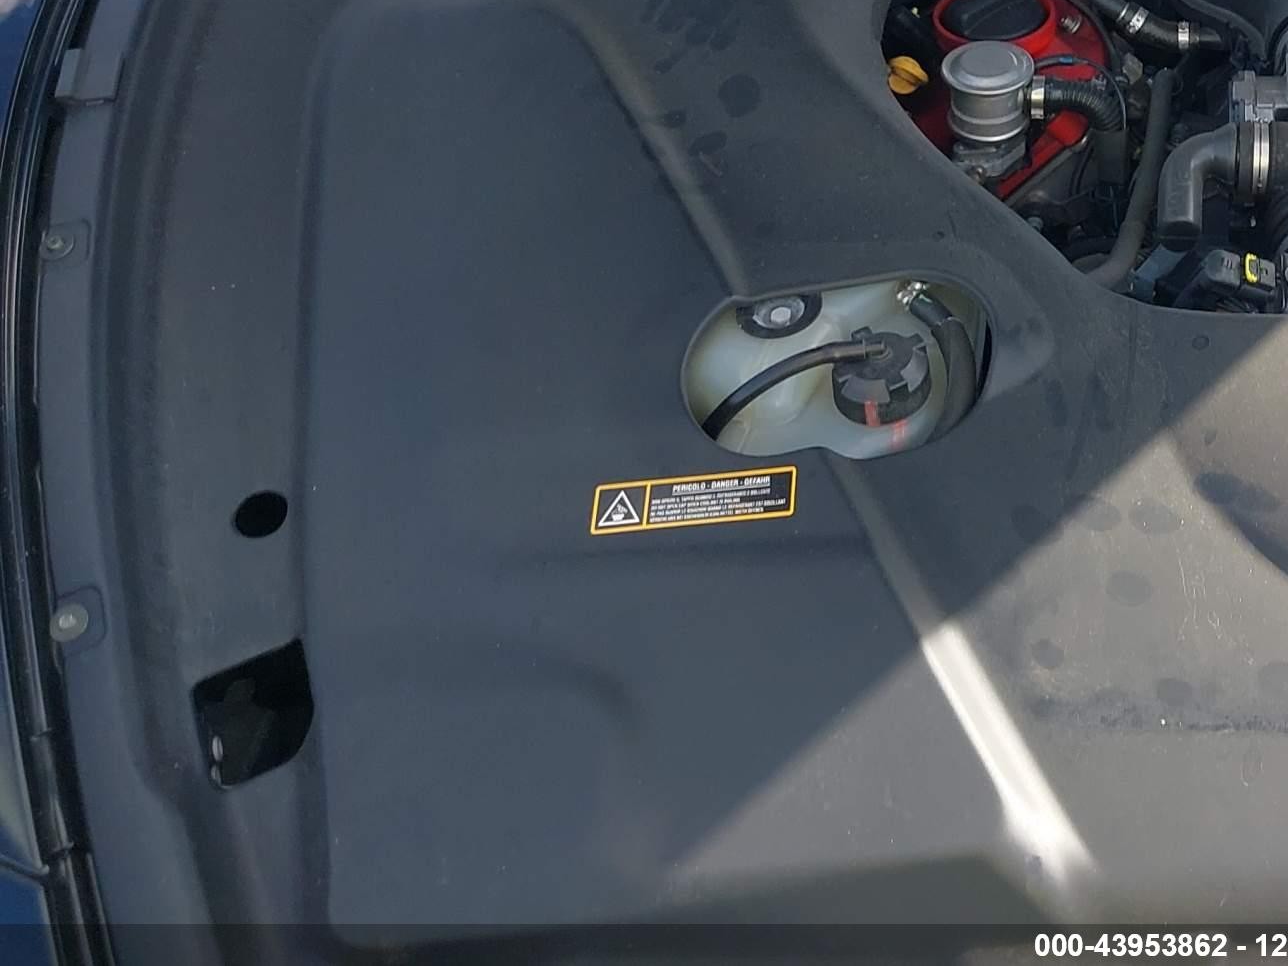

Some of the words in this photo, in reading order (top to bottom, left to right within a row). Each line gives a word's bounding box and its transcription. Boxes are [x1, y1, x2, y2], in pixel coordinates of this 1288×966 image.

[672, 482, 706, 492] PERICOLO
[711, 479, 739, 489] DANGER
[744, 476, 771, 486] GEFAHR
